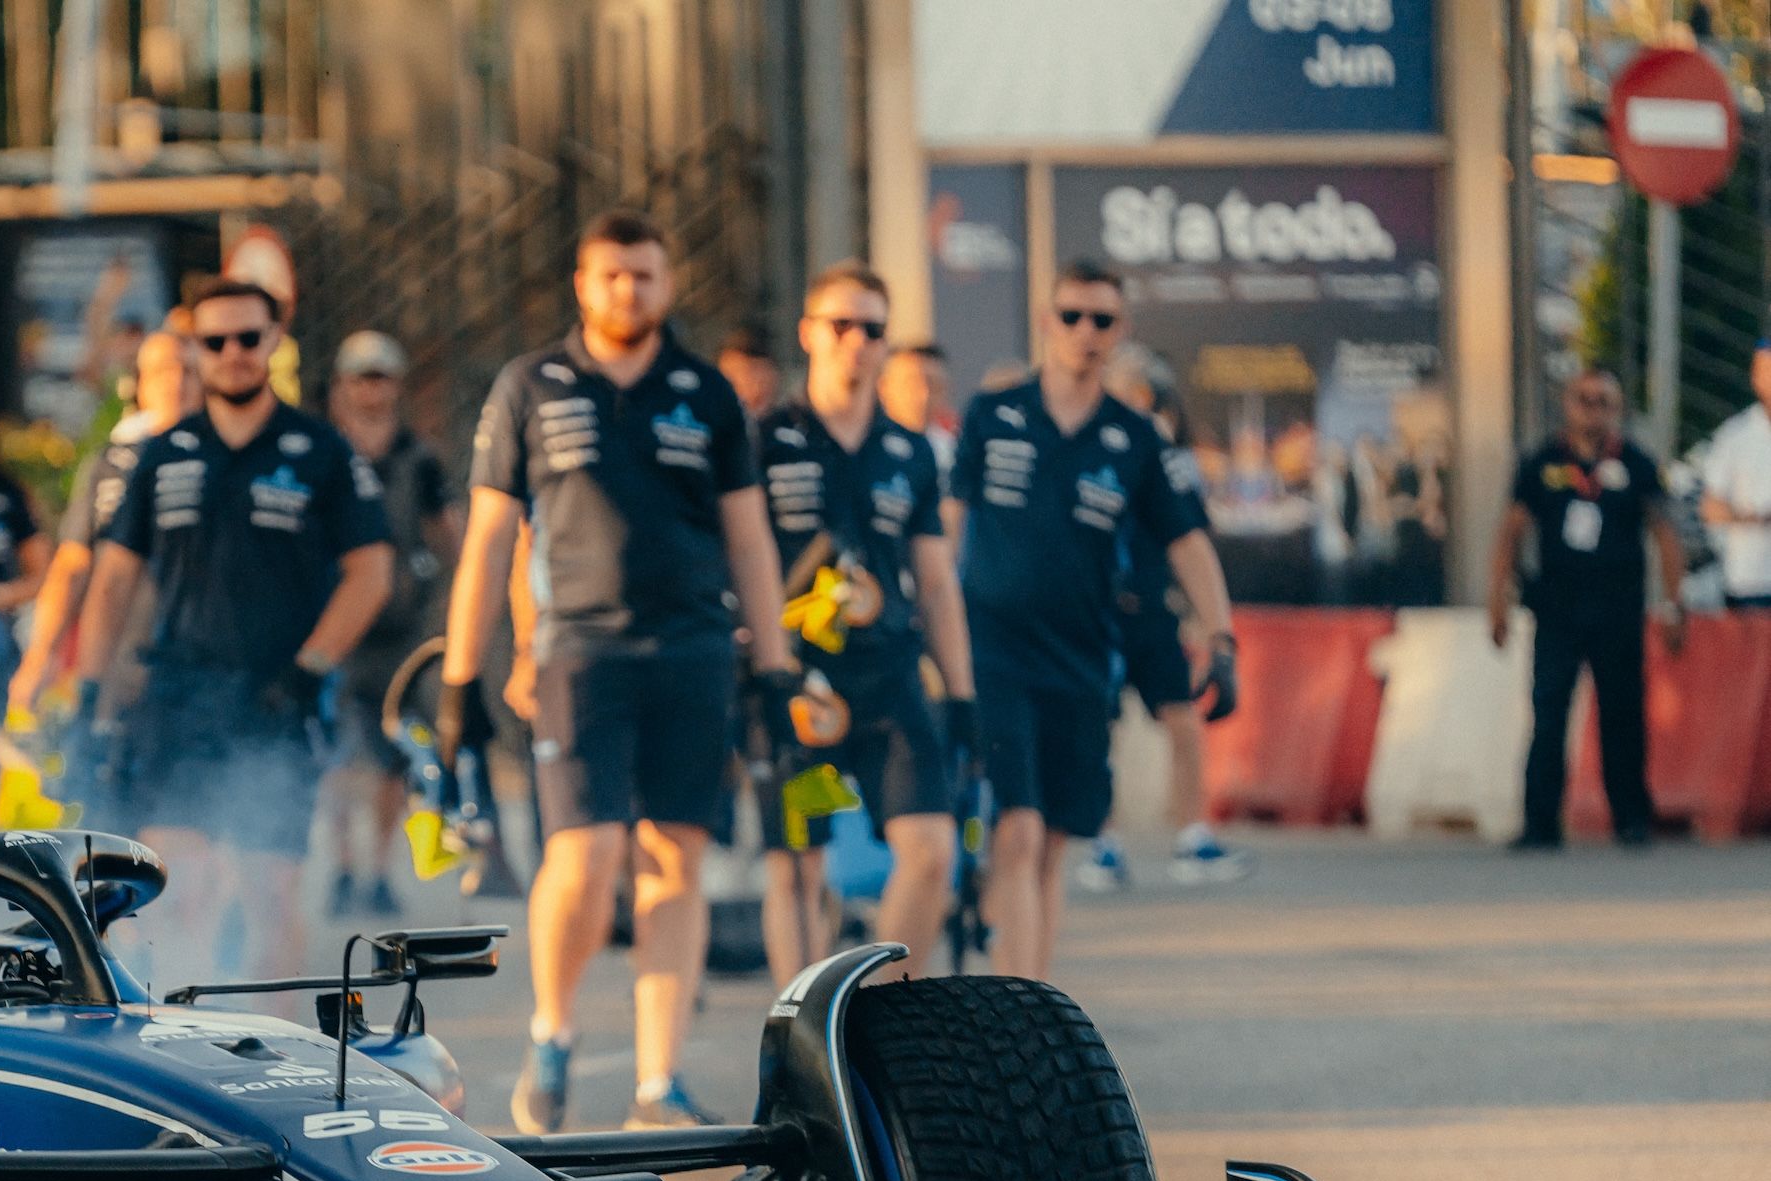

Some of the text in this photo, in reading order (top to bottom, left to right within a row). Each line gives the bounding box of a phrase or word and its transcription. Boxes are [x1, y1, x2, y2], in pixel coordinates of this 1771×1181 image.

[1302, 35, 1396, 88] Jun
[220, 1075, 406, 1095] Santander
[303, 1109, 450, 1139] 55
